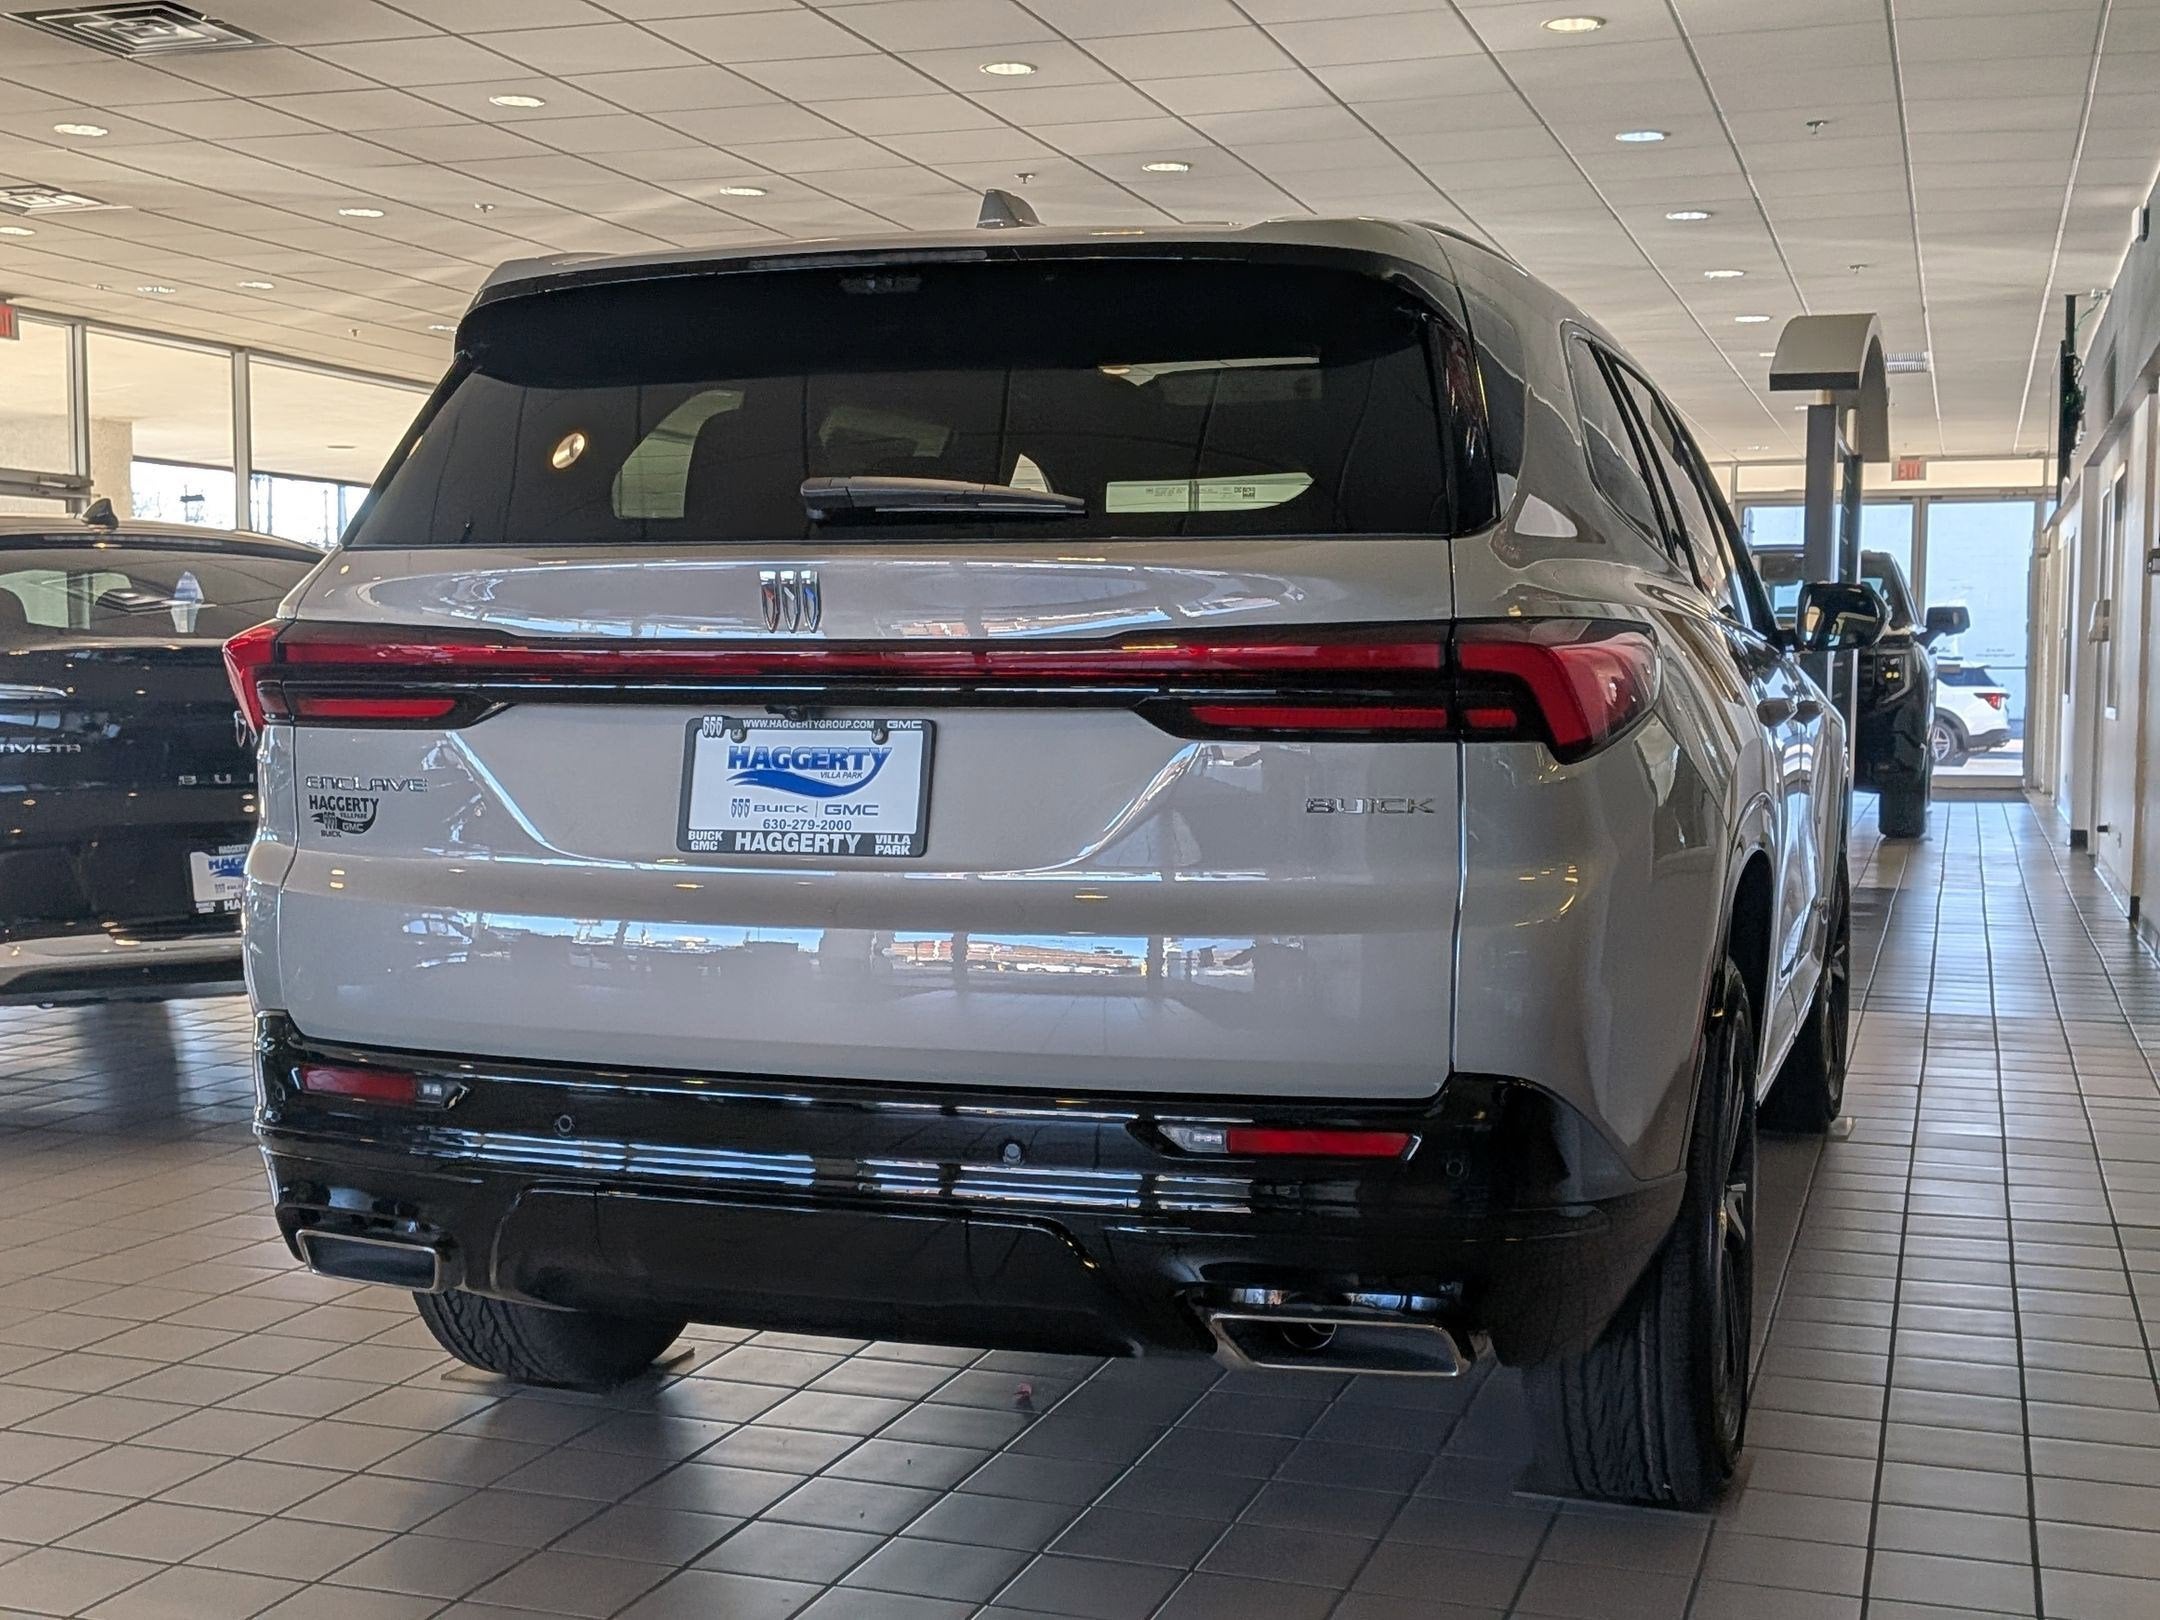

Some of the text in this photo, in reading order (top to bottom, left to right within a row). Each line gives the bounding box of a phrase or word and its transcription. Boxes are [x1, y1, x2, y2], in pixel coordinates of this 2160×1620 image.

[743, 719, 875, 729] WWW.HAGGERTYGROUP.COM
[887, 720, 922, 729] GMC
[0, 743, 82, 753] NVISTA
[727, 746, 893, 771] HAGGERTY
[178, 773, 255, 785] BUI
[305, 776, 428, 792] ENCLAVE
[309, 795, 379, 812] HAGGERTY
[1305, 797, 1436, 814] BUICK
[753, 804, 879, 816] BUICK GMC
[342, 822, 364, 832] GMC
[763, 819, 852, 831] 630-279-2000
[688, 830, 723, 841] BUICK
[875, 834, 911, 845] VILLA
[691, 841, 718, 851] GMC
[735, 832, 861, 854] HAGGERTY
[875, 845, 911, 855] PARK
